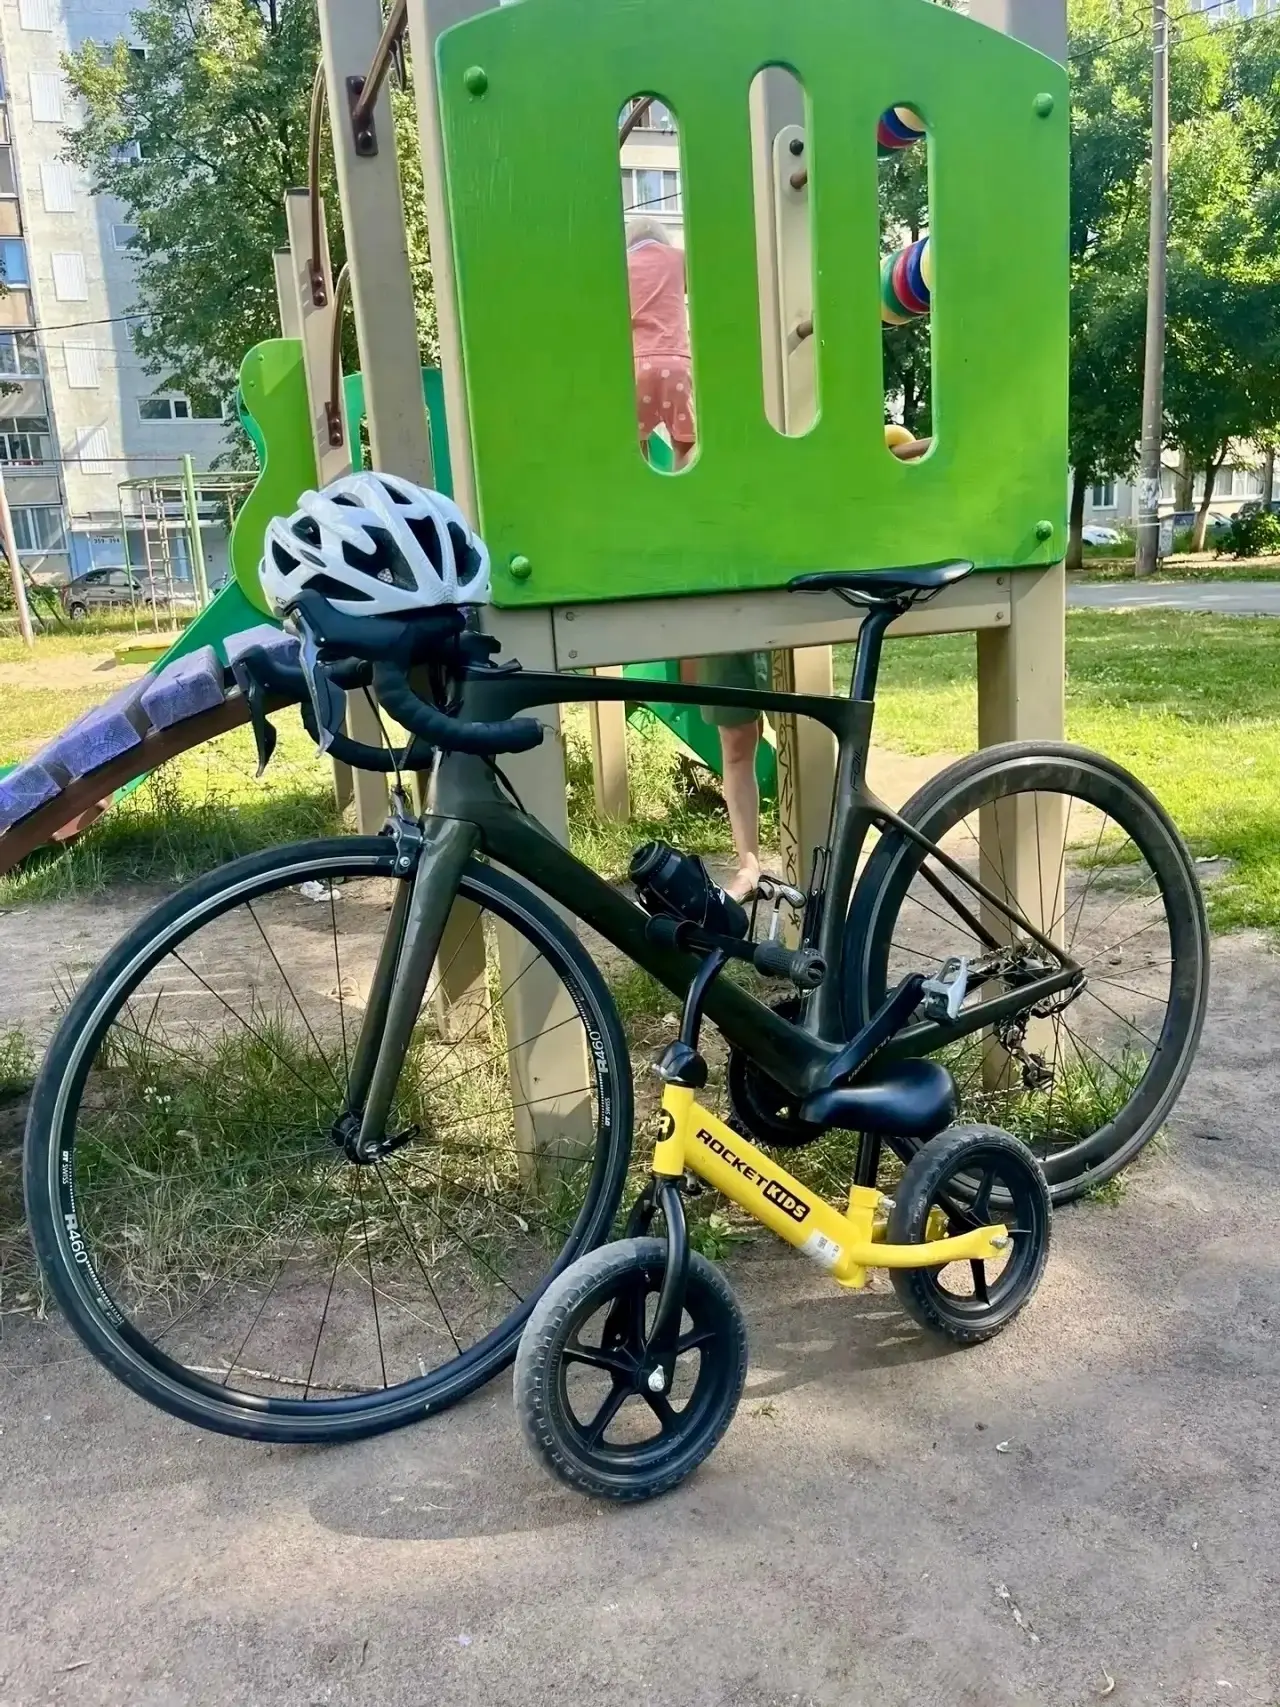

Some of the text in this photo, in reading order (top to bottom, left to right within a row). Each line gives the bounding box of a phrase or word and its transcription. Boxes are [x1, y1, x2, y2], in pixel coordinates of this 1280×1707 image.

[589, 1031, 608, 1073] R460
[604, 1116, 611, 1127] DT
[62, 1150, 69, 1162] DT
[696, 1128, 807, 1219] ROCKET KIDS
[64, 1213, 88, 1264] R460
